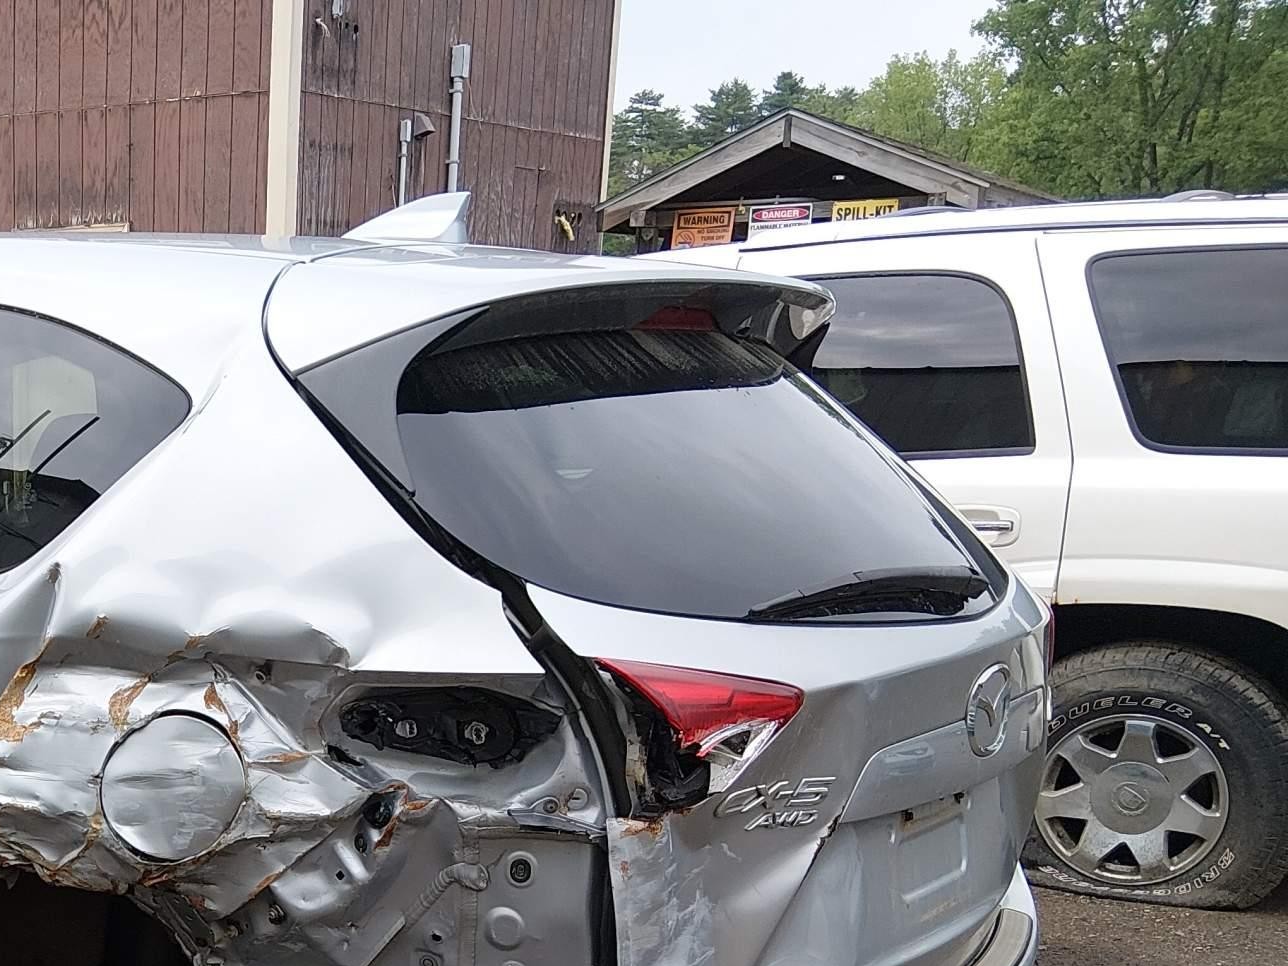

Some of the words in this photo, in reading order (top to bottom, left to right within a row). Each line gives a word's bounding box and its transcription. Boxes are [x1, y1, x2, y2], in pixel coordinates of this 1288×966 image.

[682, 214, 726, 226] WARNING
[761, 209, 800, 219] DANGER
[835, 204, 895, 221] SPILL-KIT
[1047, 695, 1193, 736] DUELER
[1196, 722, 1230, 751] A/T
[713, 776, 837, 818] CX-5
